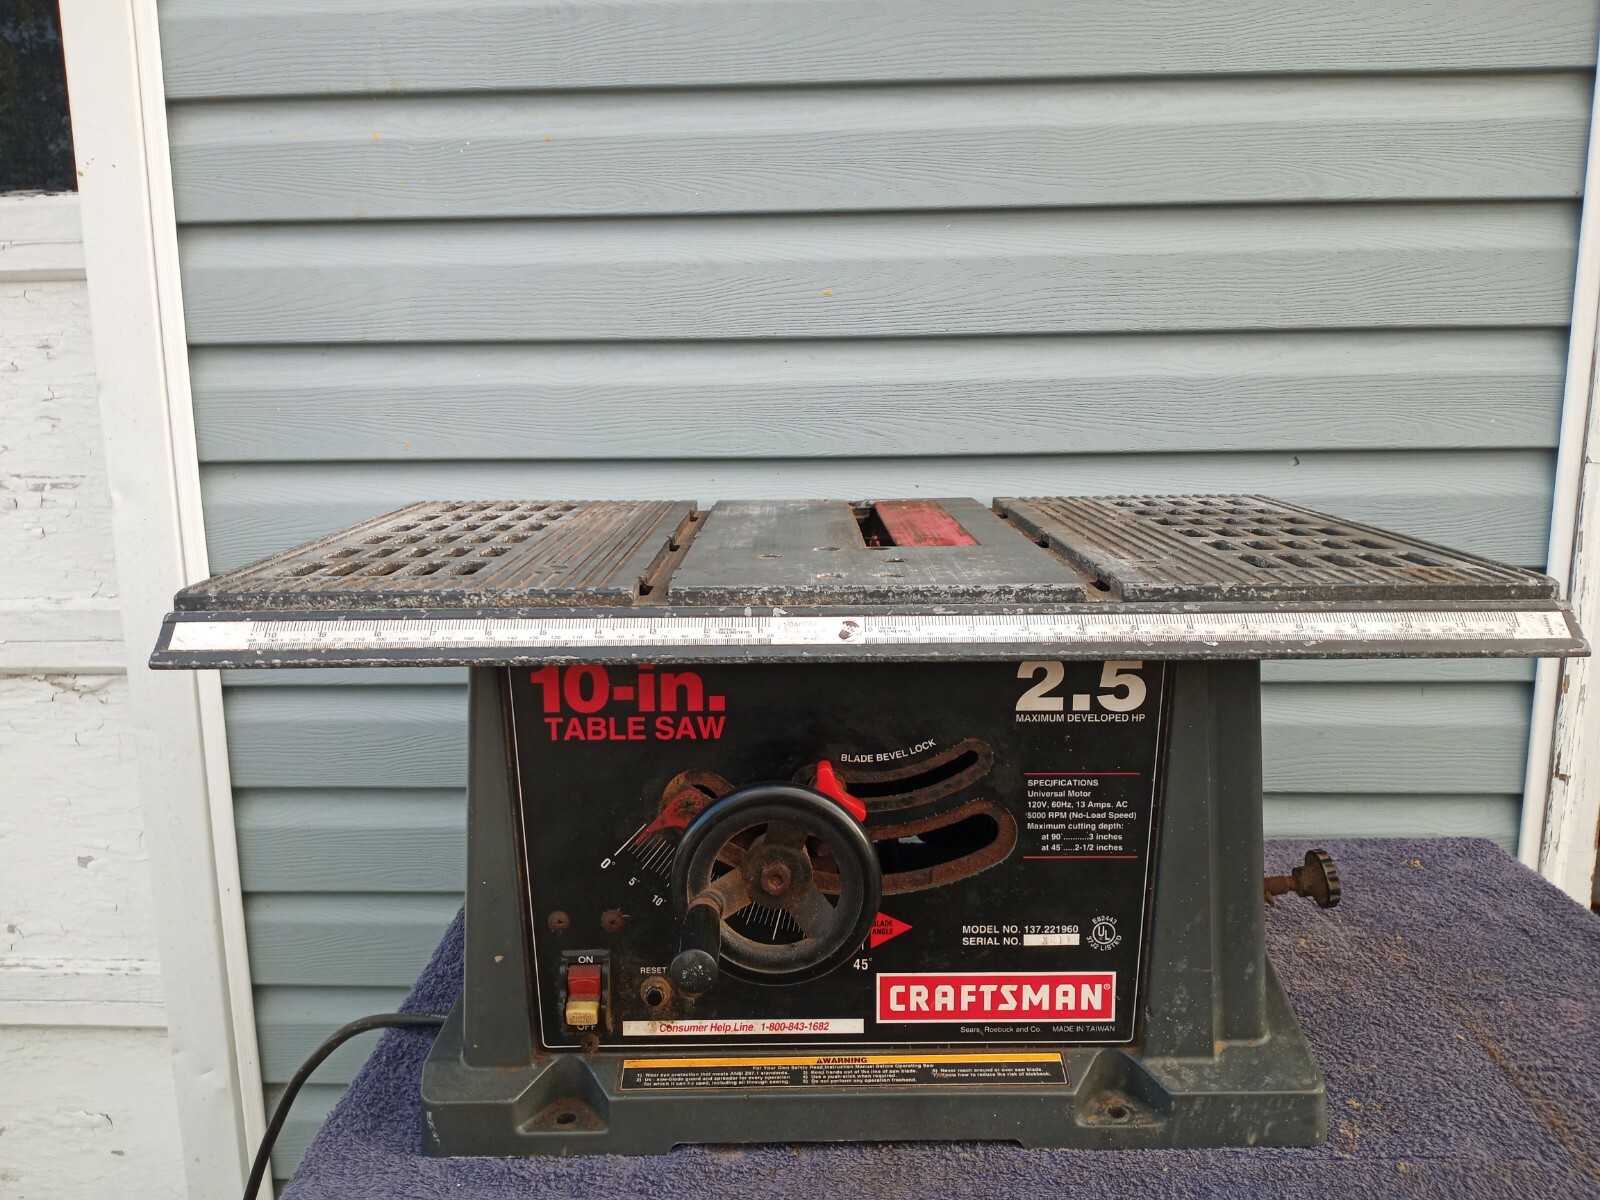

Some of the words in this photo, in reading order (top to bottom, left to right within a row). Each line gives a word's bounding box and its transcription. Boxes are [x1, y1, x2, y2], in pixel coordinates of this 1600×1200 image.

[530, 664, 726, 714] 10-in.
[1015, 660, 1147, 712] 2.5
[1015, 713, 1065, 723] MAXIMUM
[1067, 713, 1129, 722] DEVELOPED
[1131, 713, 1146, 722] HP
[544, 716, 646, 741] TABLE
[655, 715, 726, 740] SAW
[841, 753, 874, 763] BLADE
[876, 749, 908, 762] BEVEL
[909, 738, 937, 755] LOCK
[1027, 779, 1099, 787] SPECIFICATIONS
[1087, 801, 1114, 809] Amps.
[1069, 812, 1107, 820] (No-Load
[1108, 812, 1137, 820] Speed)
[1067, 823, 1096, 831] cutting
[962, 925, 1000, 934] MODEL
[1003, 925, 1021, 933] NO.
[1024, 925, 1079, 934] 137.221960
[962, 937, 1000, 946] SERIAL
[1003, 937, 1021, 945] NO.
[1100, 935, 1122, 951] LISTED
[578, 956, 594, 964] ON
[640, 966, 667, 974] RESET
[659, 1023, 708, 1032] Consumer
[710, 1022, 731, 1033] Help
[761, 1022, 830, 1031] 1-800-843-1682
